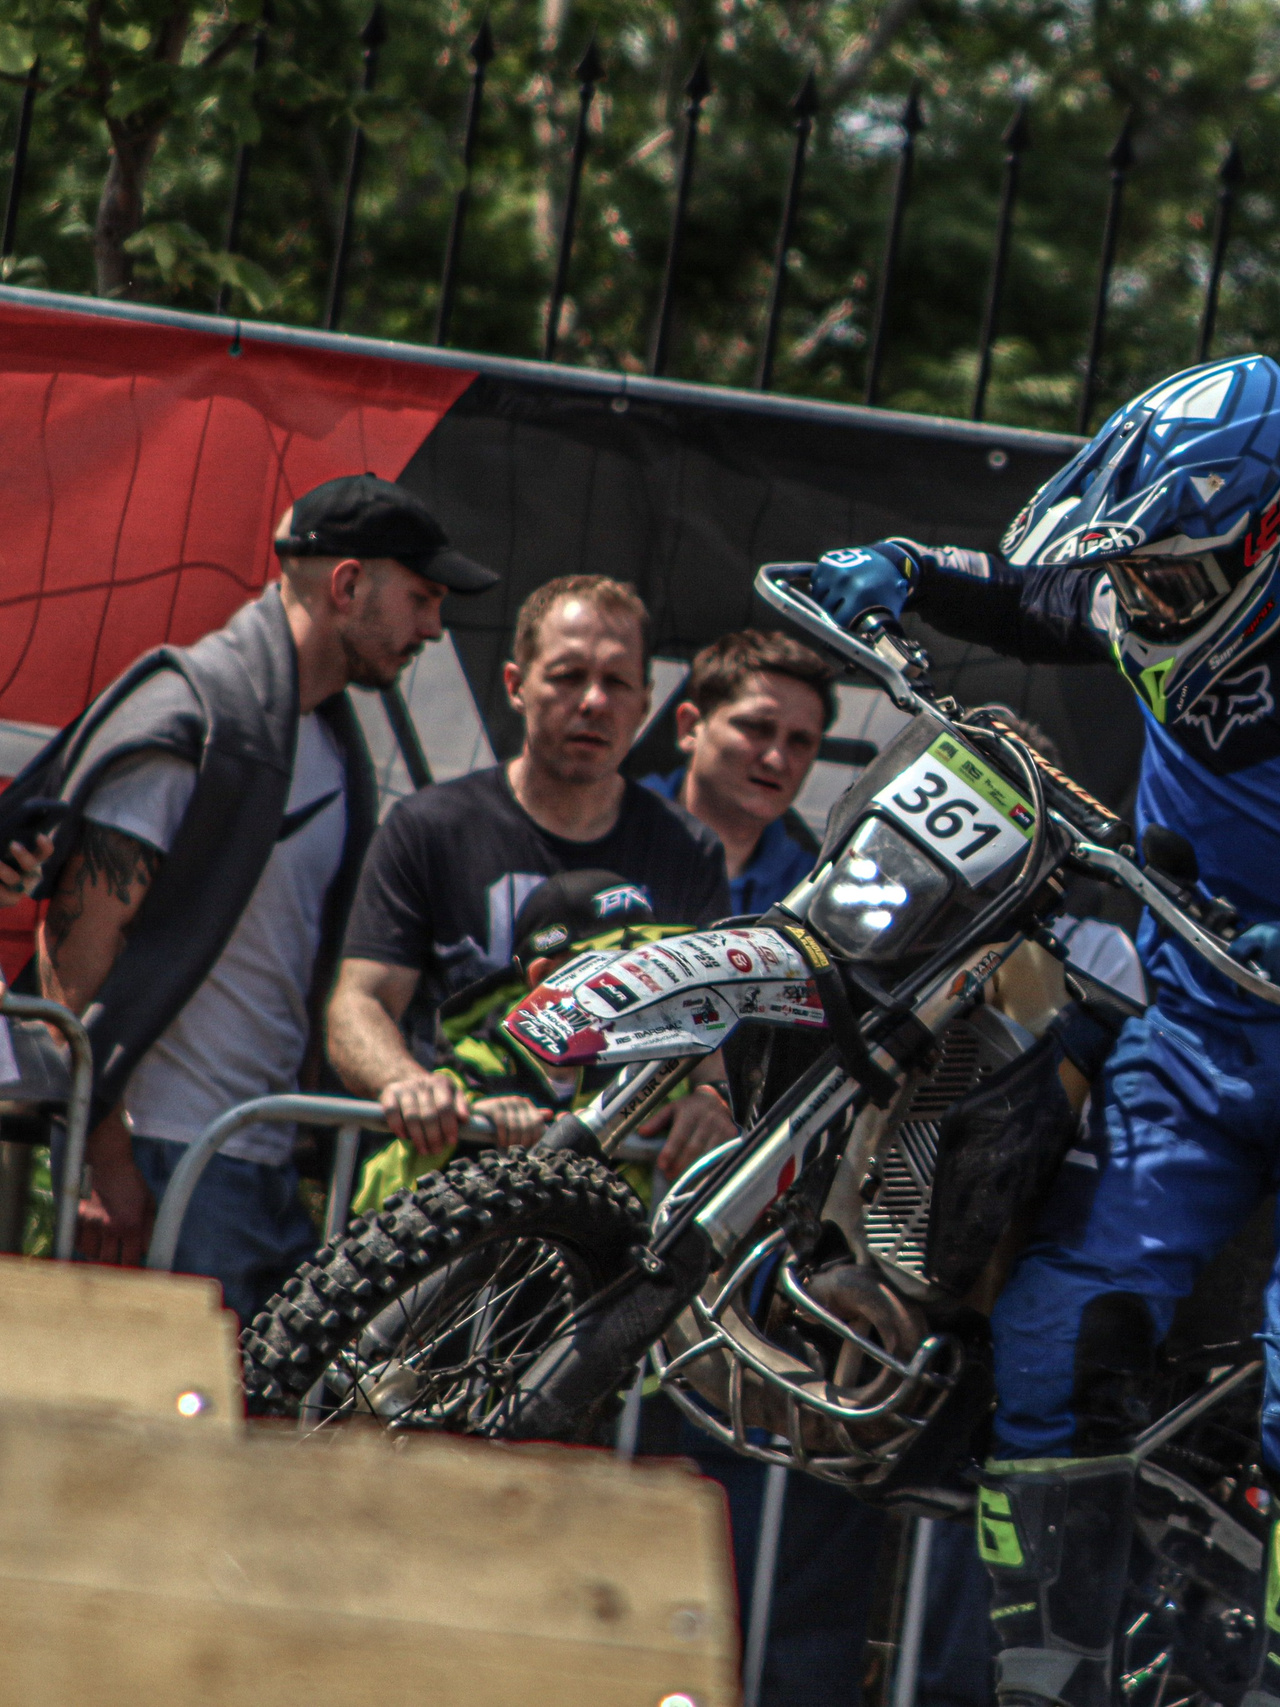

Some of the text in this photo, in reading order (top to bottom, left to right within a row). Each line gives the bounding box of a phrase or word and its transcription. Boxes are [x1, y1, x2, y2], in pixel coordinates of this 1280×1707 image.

[1054, 528, 1135, 563] Airoh
[892, 772, 1002, 861] 361
[651, 958, 680, 984] KENDA
[693, 954, 714, 969] 23
[519, 1020, 561, 1054] ПУТЬ
[540, 1010, 573, 1037] ENDURO
[620, 1076, 661, 1120] XPLOR
